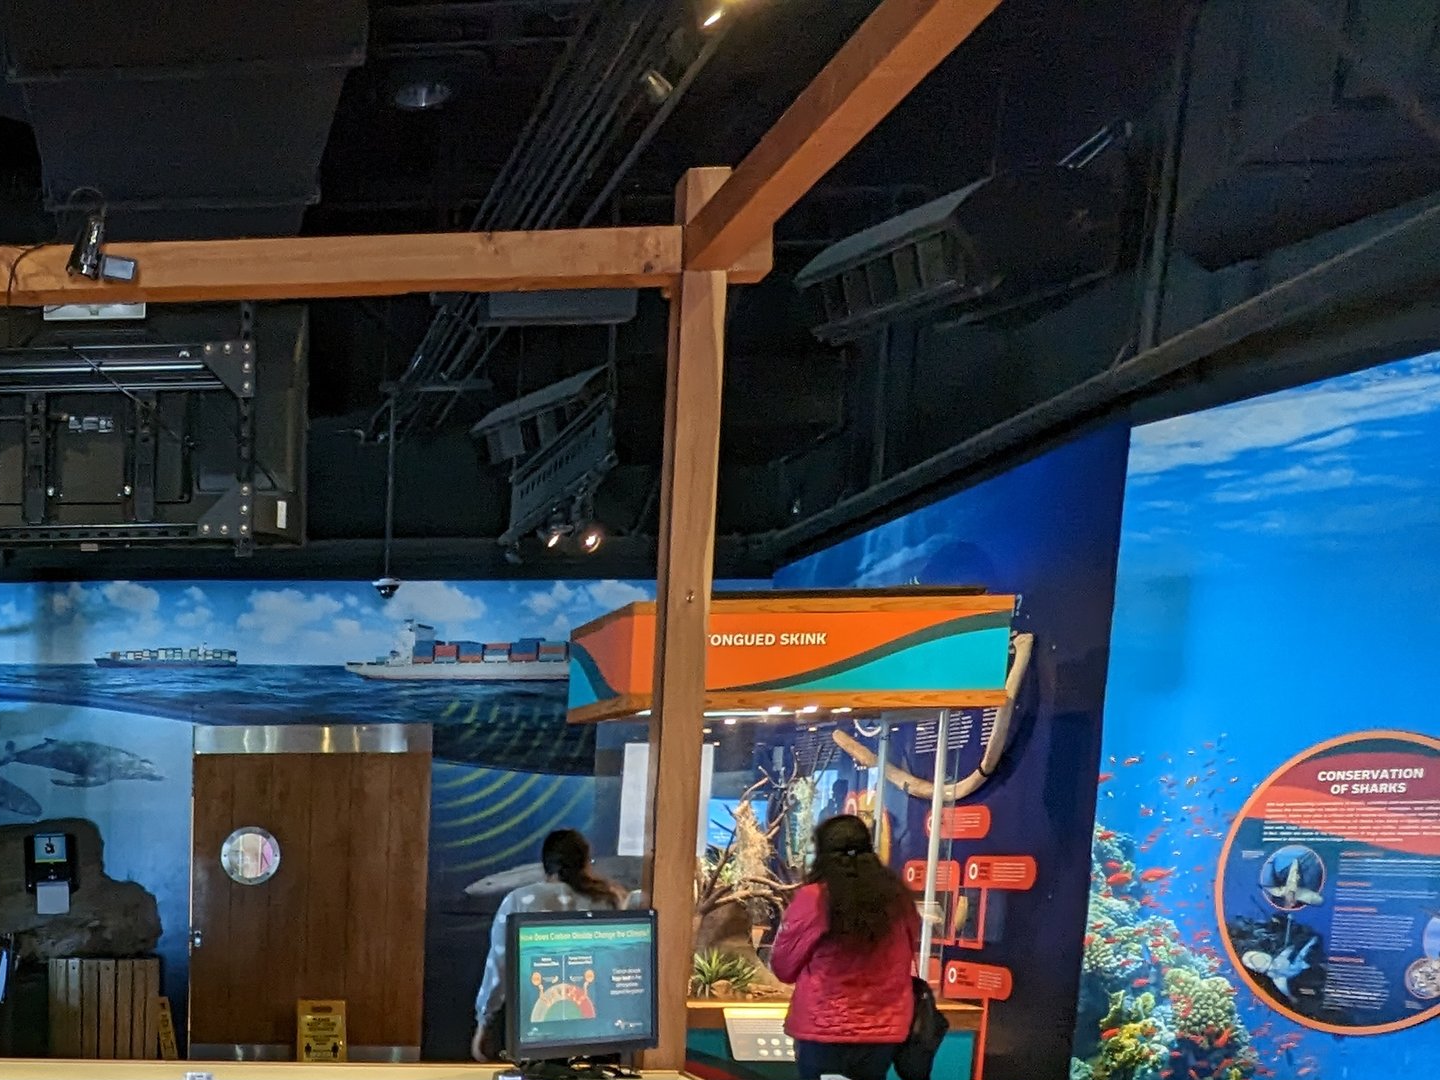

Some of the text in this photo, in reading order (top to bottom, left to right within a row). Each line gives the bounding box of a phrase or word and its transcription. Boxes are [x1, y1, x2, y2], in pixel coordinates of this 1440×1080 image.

[708, 633, 826, 646] ONGUED SKINK
[1317, 768, 1424, 782] CONSERVATION
[1330, 782, 1407, 794] OF SHARKS
